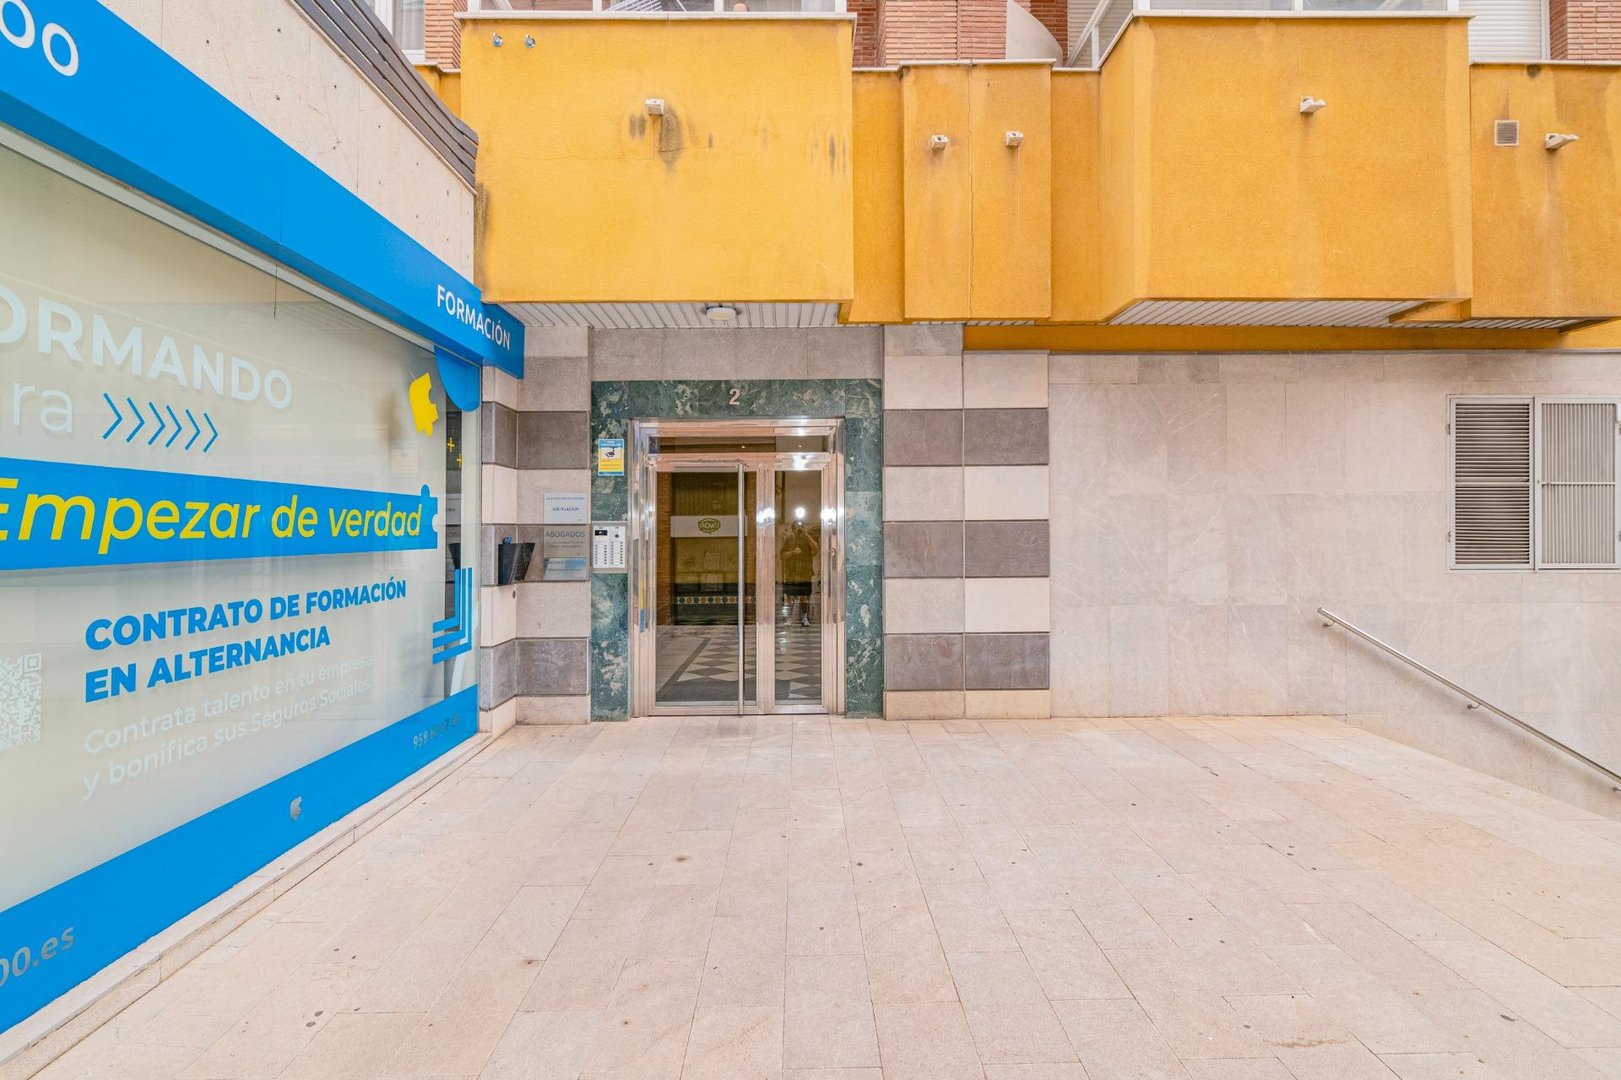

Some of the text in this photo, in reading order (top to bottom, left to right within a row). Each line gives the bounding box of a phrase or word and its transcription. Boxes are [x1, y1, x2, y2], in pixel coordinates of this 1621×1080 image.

[437, 284, 511, 350] FORMACIÓN
[728, 388, 741, 406] 2
[271, 494, 319, 539] de
[328, 501, 423, 537] verdad
[545, 530, 586, 538] ABOGADOS
[85, 576, 407, 651] CONTRATO DE FORMACIÓN
[85, 625, 331, 703] EN ALTERNANCIA
[84, 706, 197, 754] Contrata
[203, 684, 270, 718] talento
[275, 677, 295, 695] en
[318, 654, 373, 682] empresa
[83, 771, 99, 801] y
[109, 735, 208, 785] bonifica
[213, 721, 247, 746] sus
[252, 695, 317, 733] Seguros
